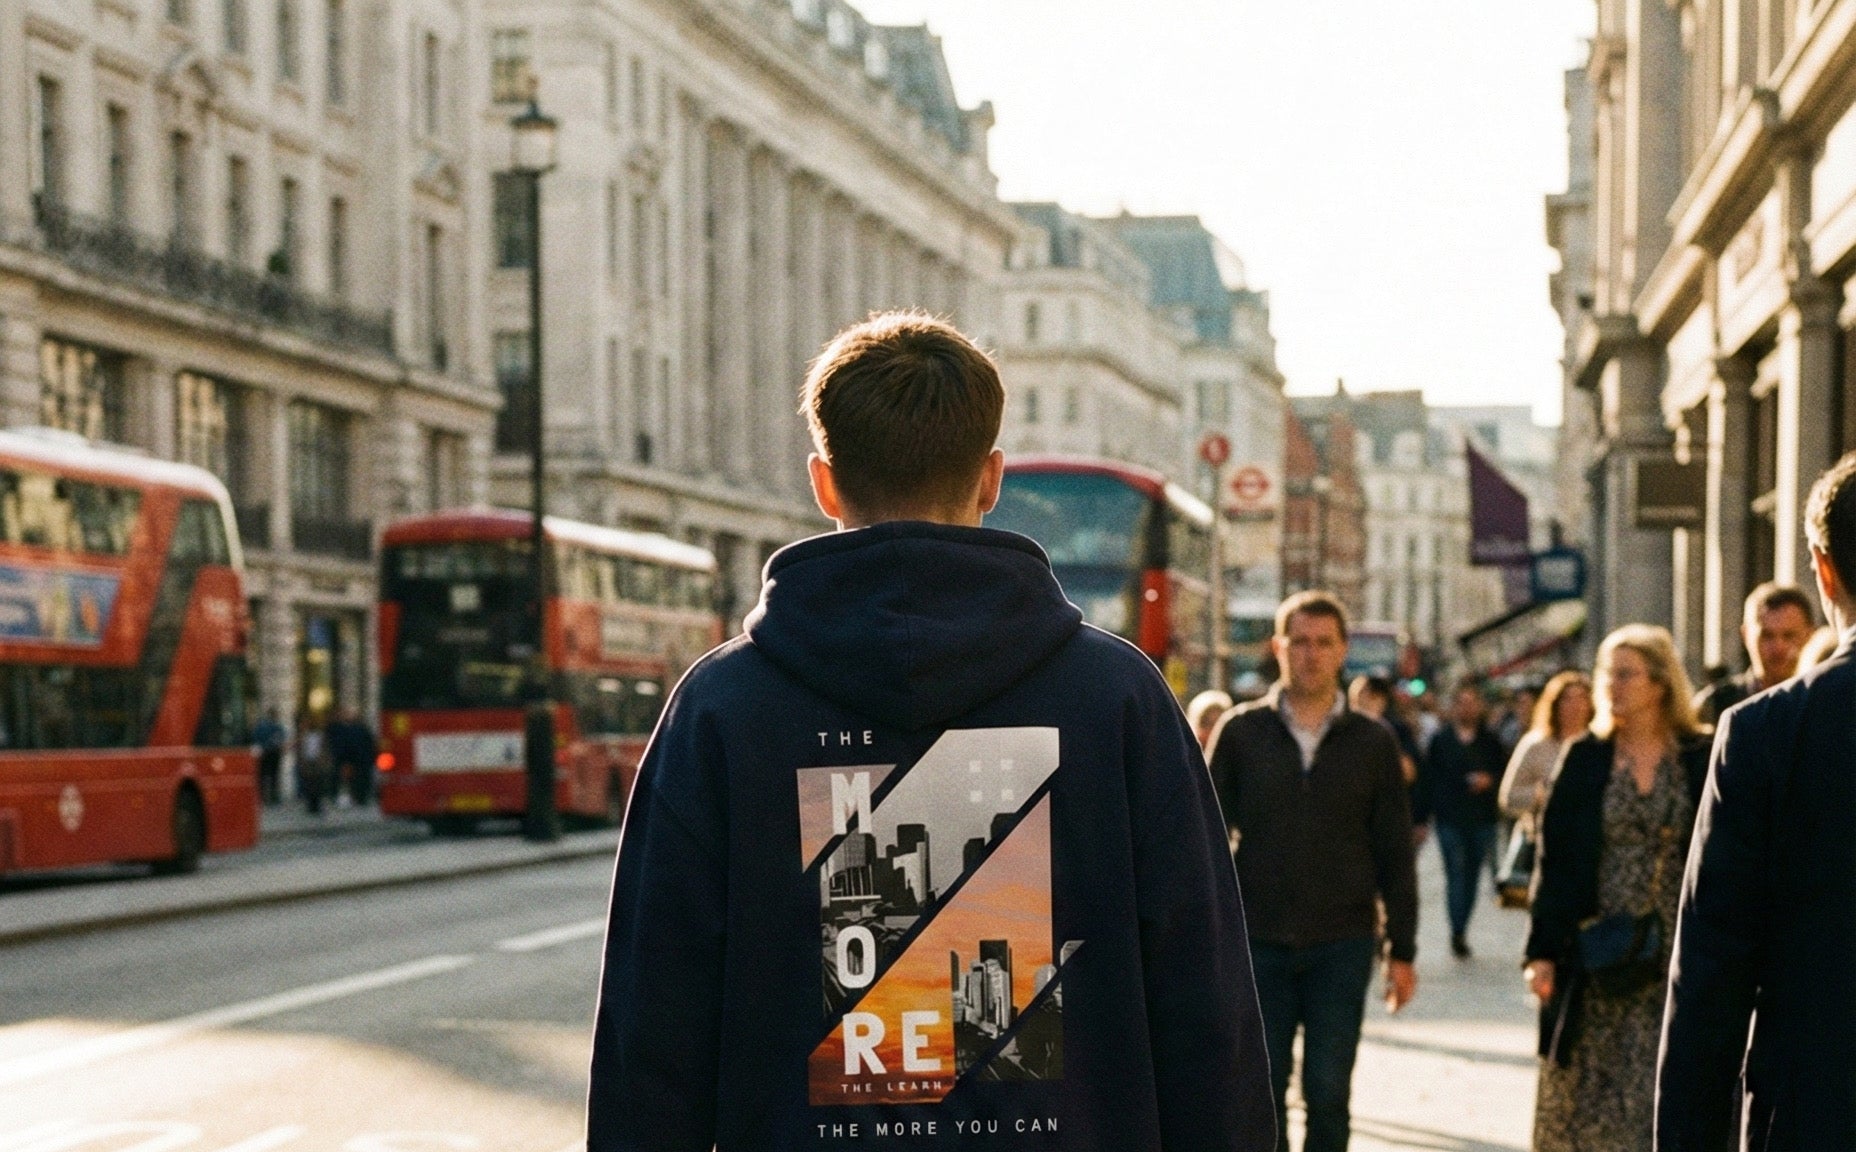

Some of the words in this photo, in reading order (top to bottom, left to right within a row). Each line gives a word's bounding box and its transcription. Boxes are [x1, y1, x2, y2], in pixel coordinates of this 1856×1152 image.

[818, 729, 873, 747] THE
[842, 1009, 942, 1076] RE
[840, 1083, 873, 1094] THE
[817, 1123, 859, 1138] THE
[876, 1121, 938, 1137] MORE
[955, 1119, 999, 1135] YOU
[1015, 1117, 1059, 1133] CAN
